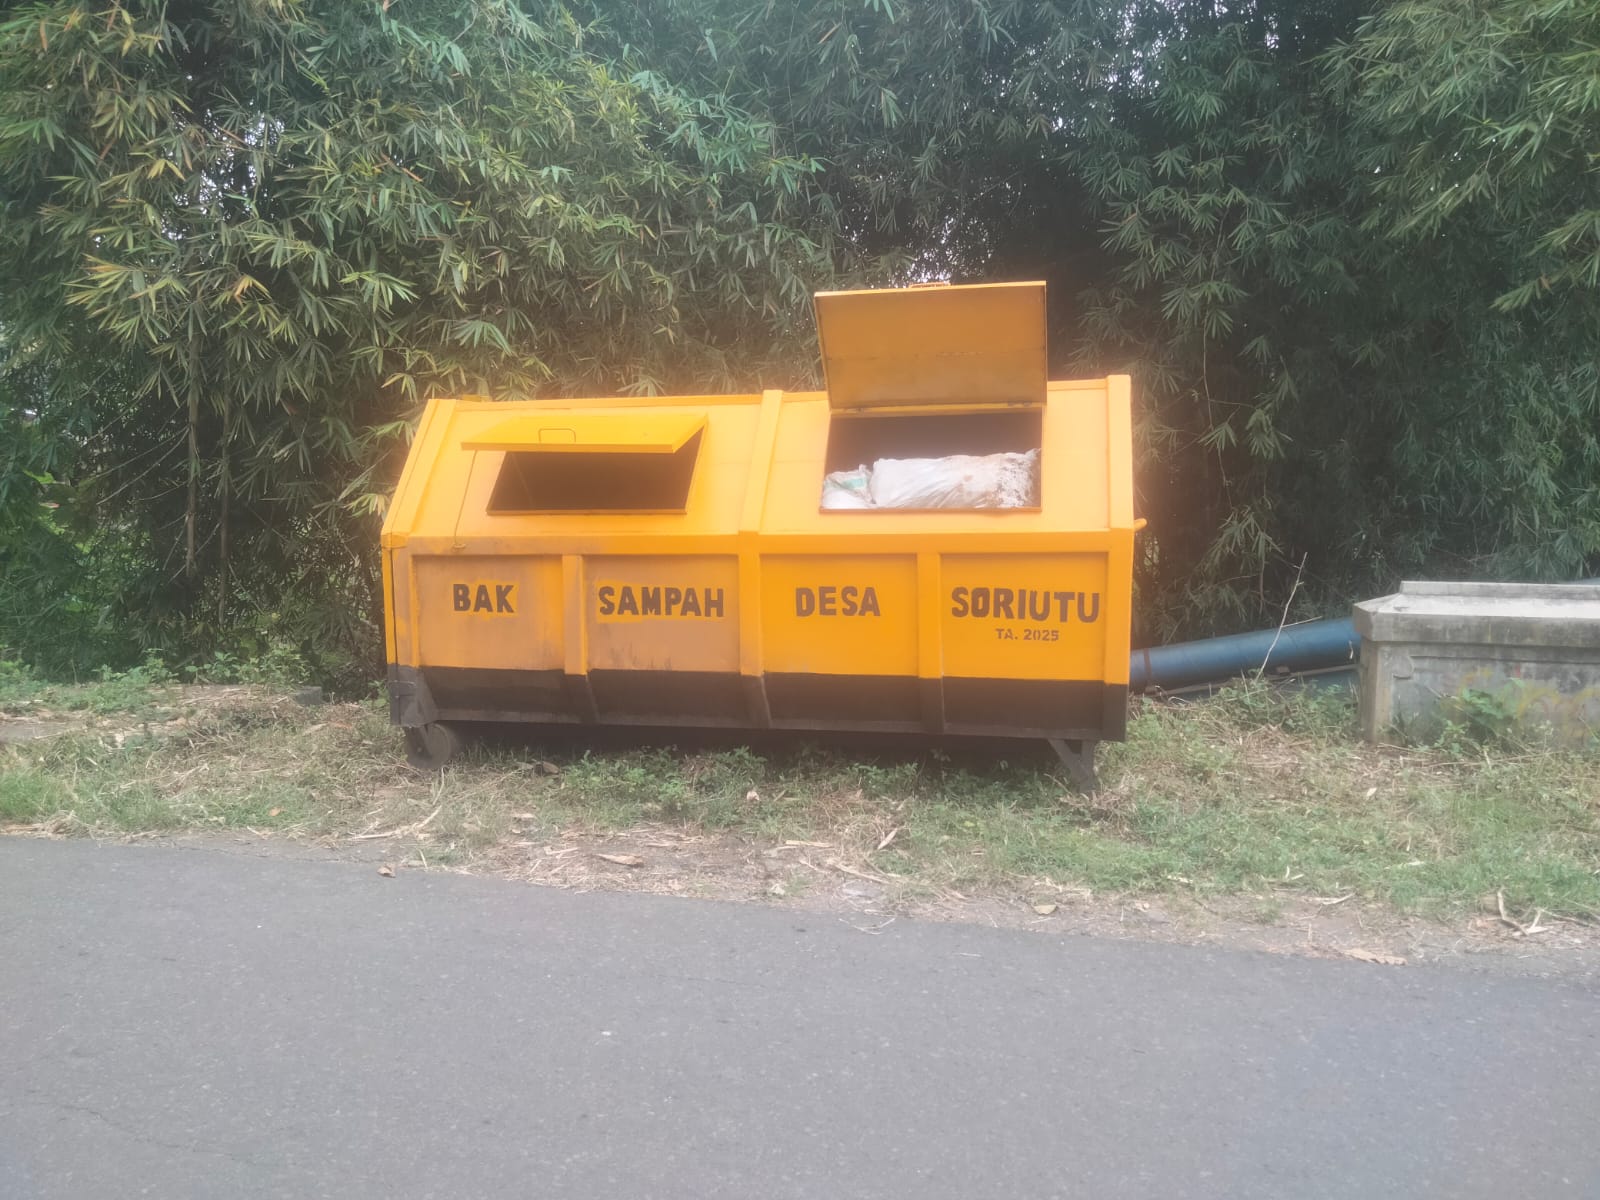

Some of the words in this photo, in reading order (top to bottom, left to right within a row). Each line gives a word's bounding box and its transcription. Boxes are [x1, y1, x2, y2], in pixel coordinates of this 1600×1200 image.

[453, 583, 514, 613] BAK
[598, 585, 724, 618] SAMPAH
[796, 586, 881, 617] DESA
[951, 586, 1100, 623] SORIUTU
[995, 628, 1019, 641] TA.
[1023, 628, 1060, 642] 2025
